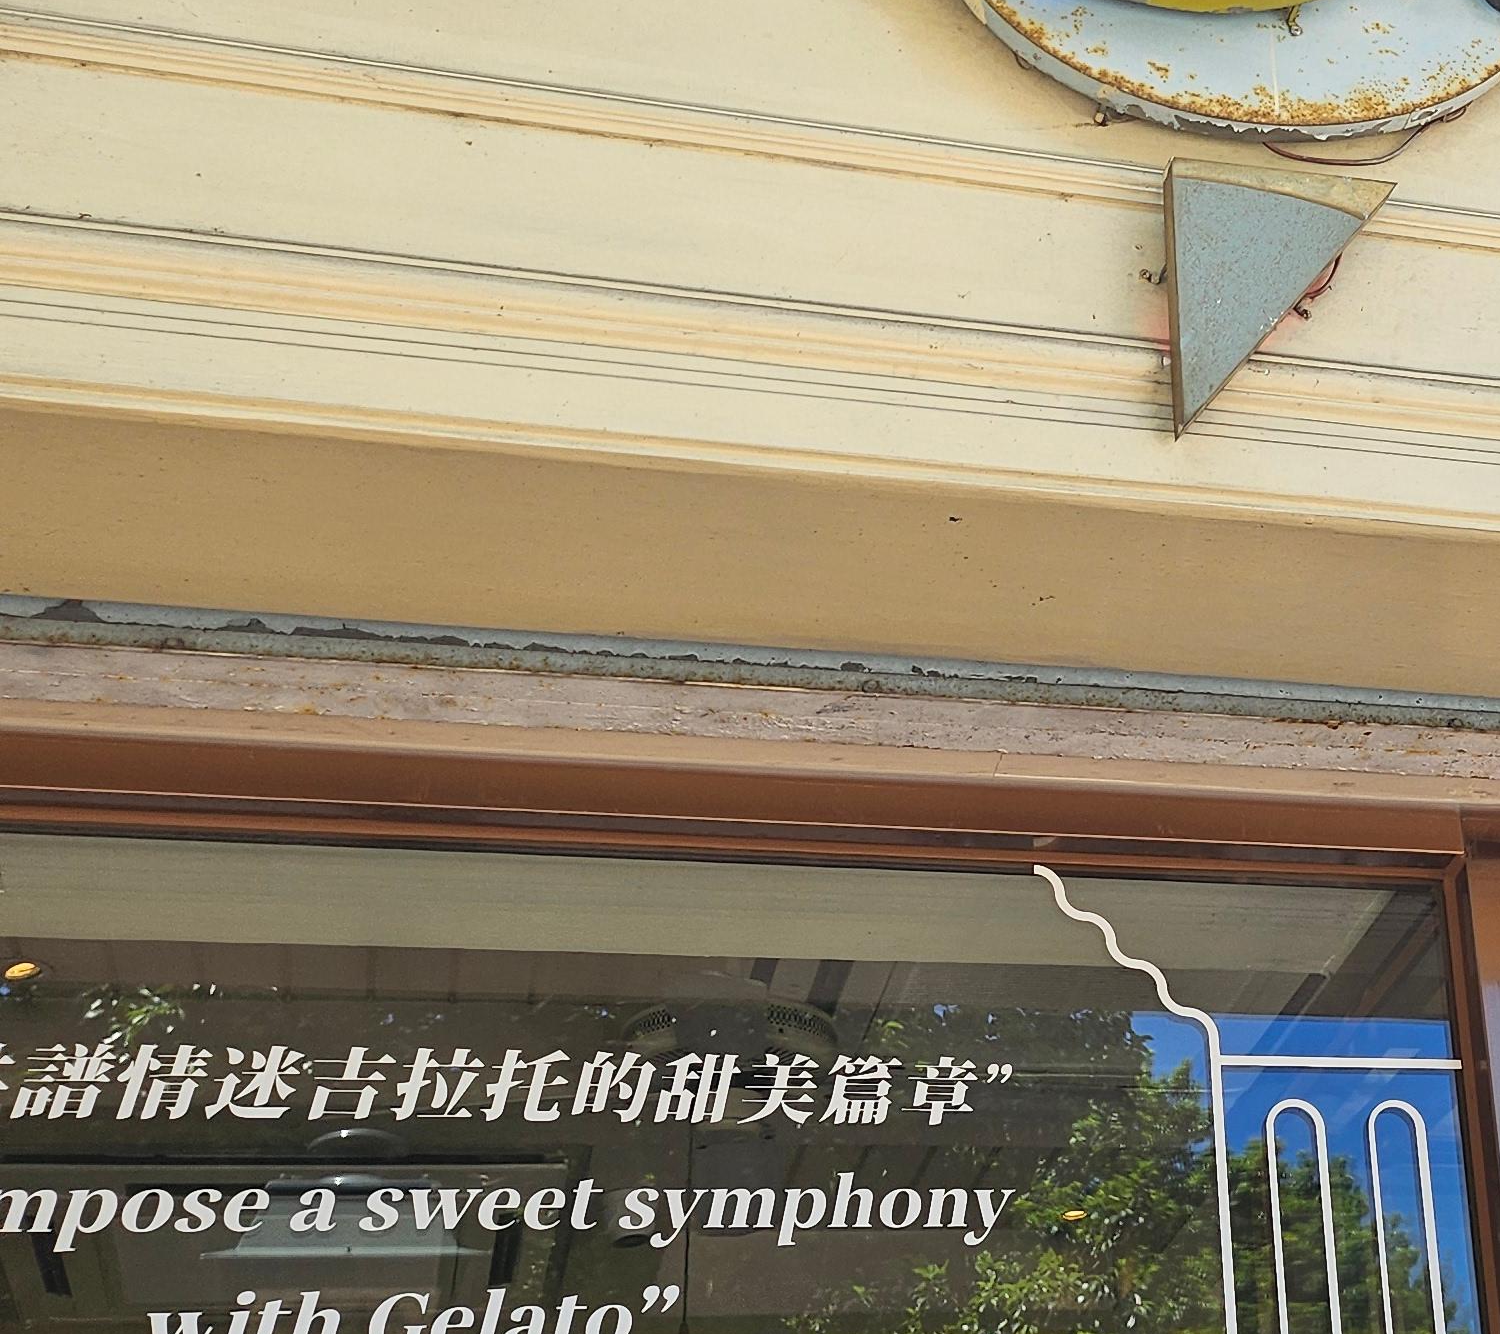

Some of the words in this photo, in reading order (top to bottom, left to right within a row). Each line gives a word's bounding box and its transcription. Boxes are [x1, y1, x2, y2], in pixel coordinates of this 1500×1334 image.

[0, 1044, 1013, 1126] 譜情迷吉拉托的甜美篇章”
[289, 1188, 337, 1232] a
[358, 1178, 604, 1232] sweet
[618, 1171, 1017, 1248] symphony
